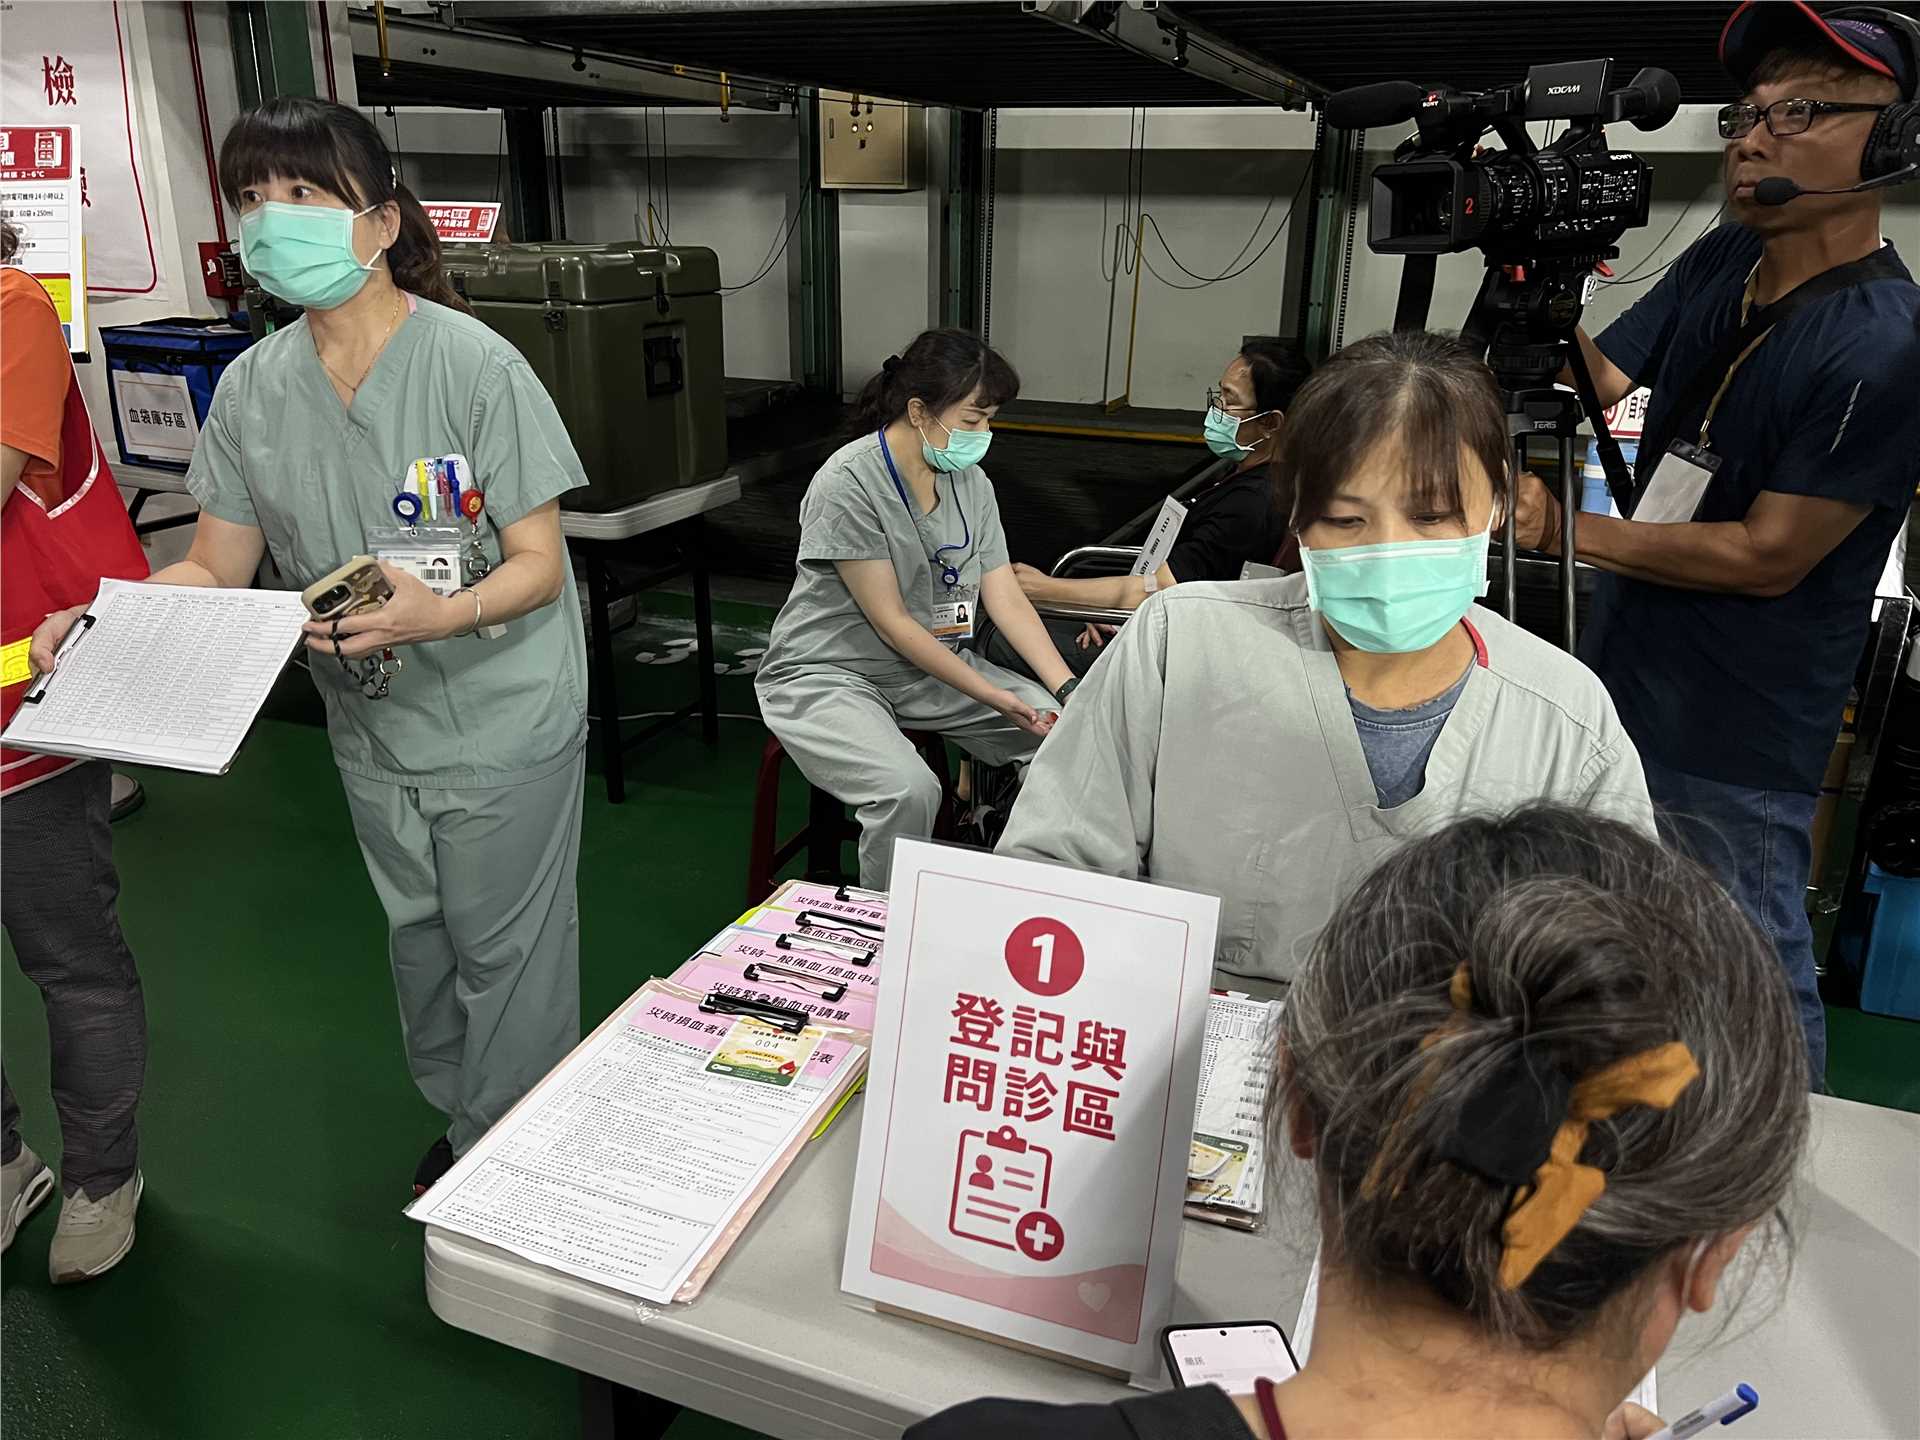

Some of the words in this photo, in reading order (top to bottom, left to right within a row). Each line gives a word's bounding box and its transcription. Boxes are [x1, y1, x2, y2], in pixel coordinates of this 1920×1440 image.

[1546, 85, 1581, 95] XDCAM
[1465, 197, 1474, 214] 2
[128, 407, 187, 429] 血袋庫存區
[797, 896, 887, 919] 災時血液庫存量
[1031, 932, 1056, 984] 1
[949, 991, 1127, 1082] 登記與
[943, 1052, 1121, 1141] 問診區
